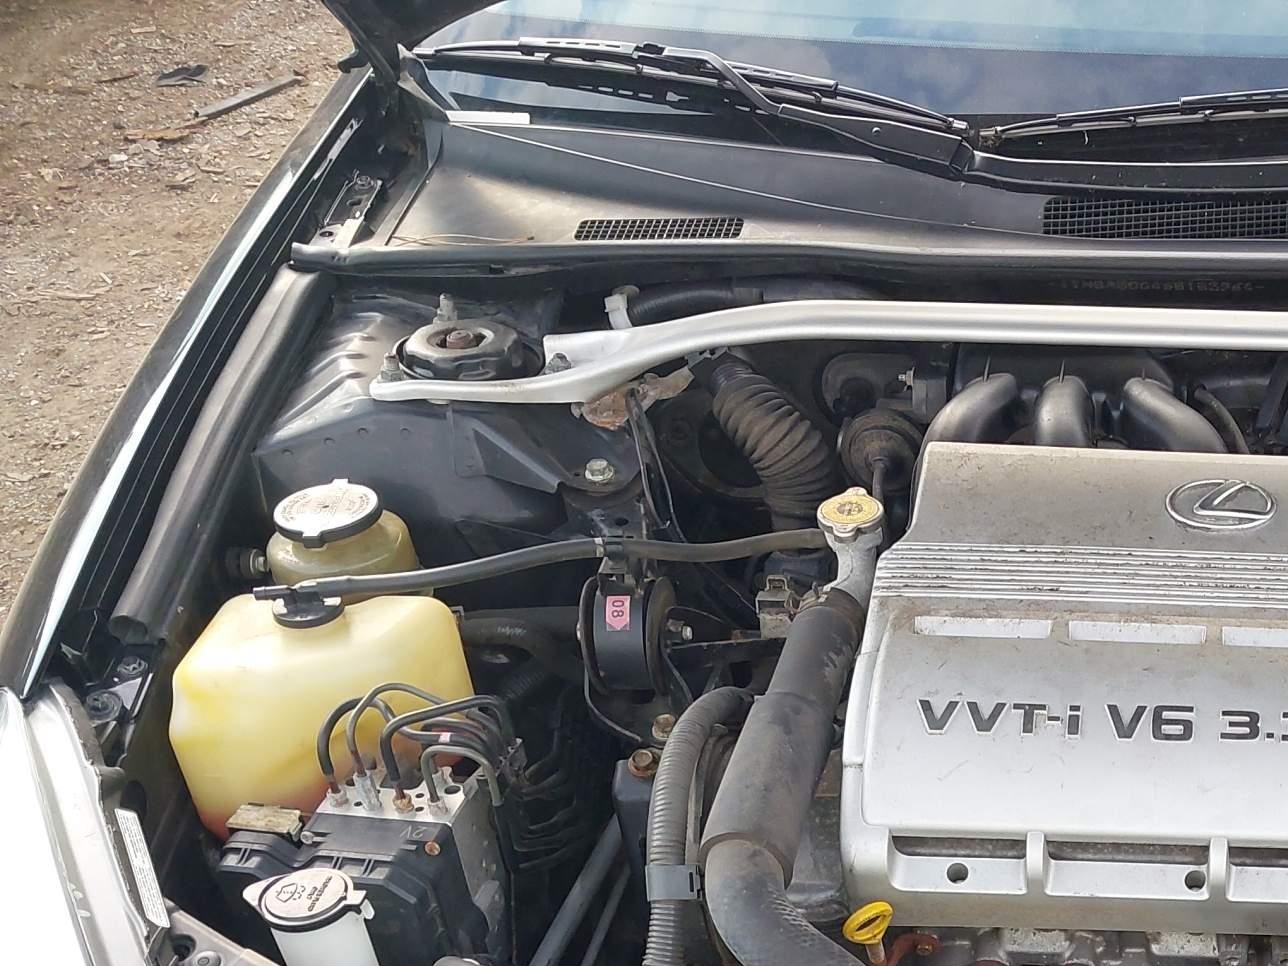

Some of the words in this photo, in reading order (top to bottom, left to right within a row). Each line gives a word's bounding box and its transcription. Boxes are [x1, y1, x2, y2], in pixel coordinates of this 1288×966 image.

[611, 599, 625, 619] 08
[917, 698, 1082, 740] VVT-i
[1104, 703, 1197, 742] V6
